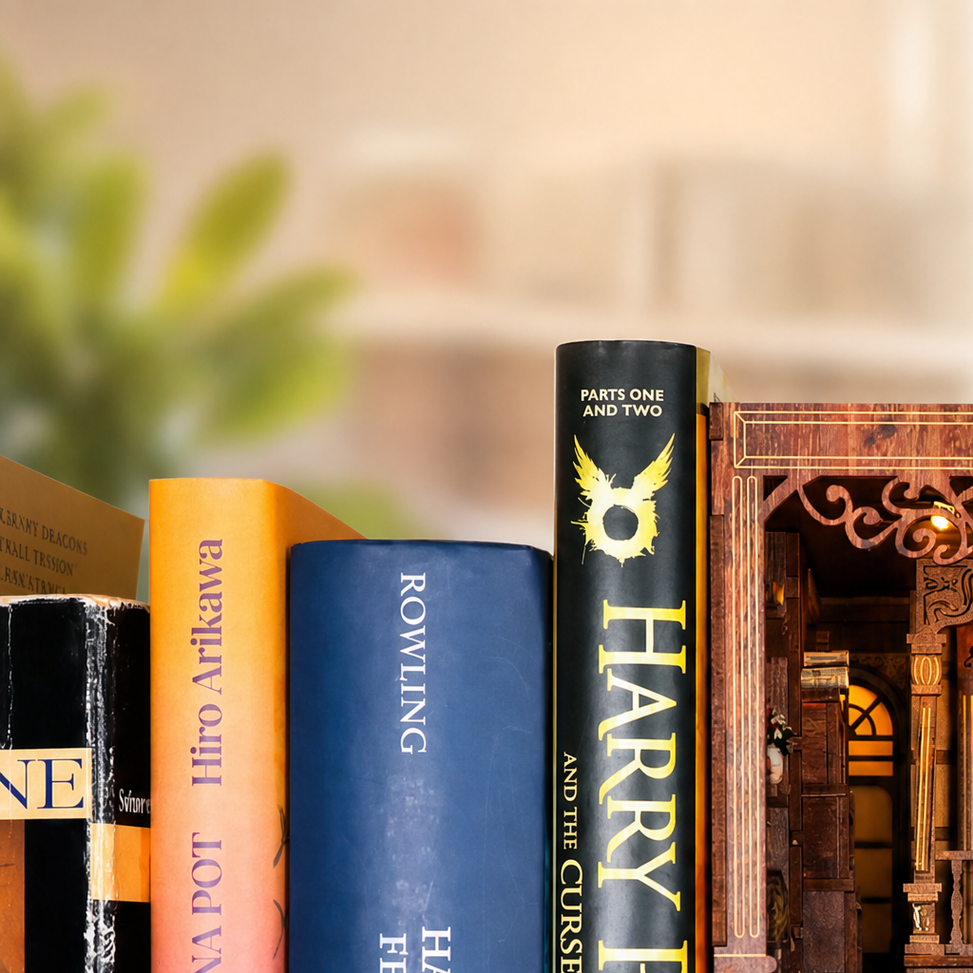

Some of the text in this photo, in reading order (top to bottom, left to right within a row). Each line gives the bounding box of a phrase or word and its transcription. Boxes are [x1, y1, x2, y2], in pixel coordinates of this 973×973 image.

[580, 388, 664, 401] PARTS ONE
[583, 404, 663, 417] AND TWO
[190, 538, 223, 787] Hiro Arikawa
[400, 572, 427, 755] ROWLING
[563, 751, 578, 802] AND
[598, 599, 686, 911] HARRY
[563, 806, 578, 850] THE
[191, 832, 222, 916] POT
